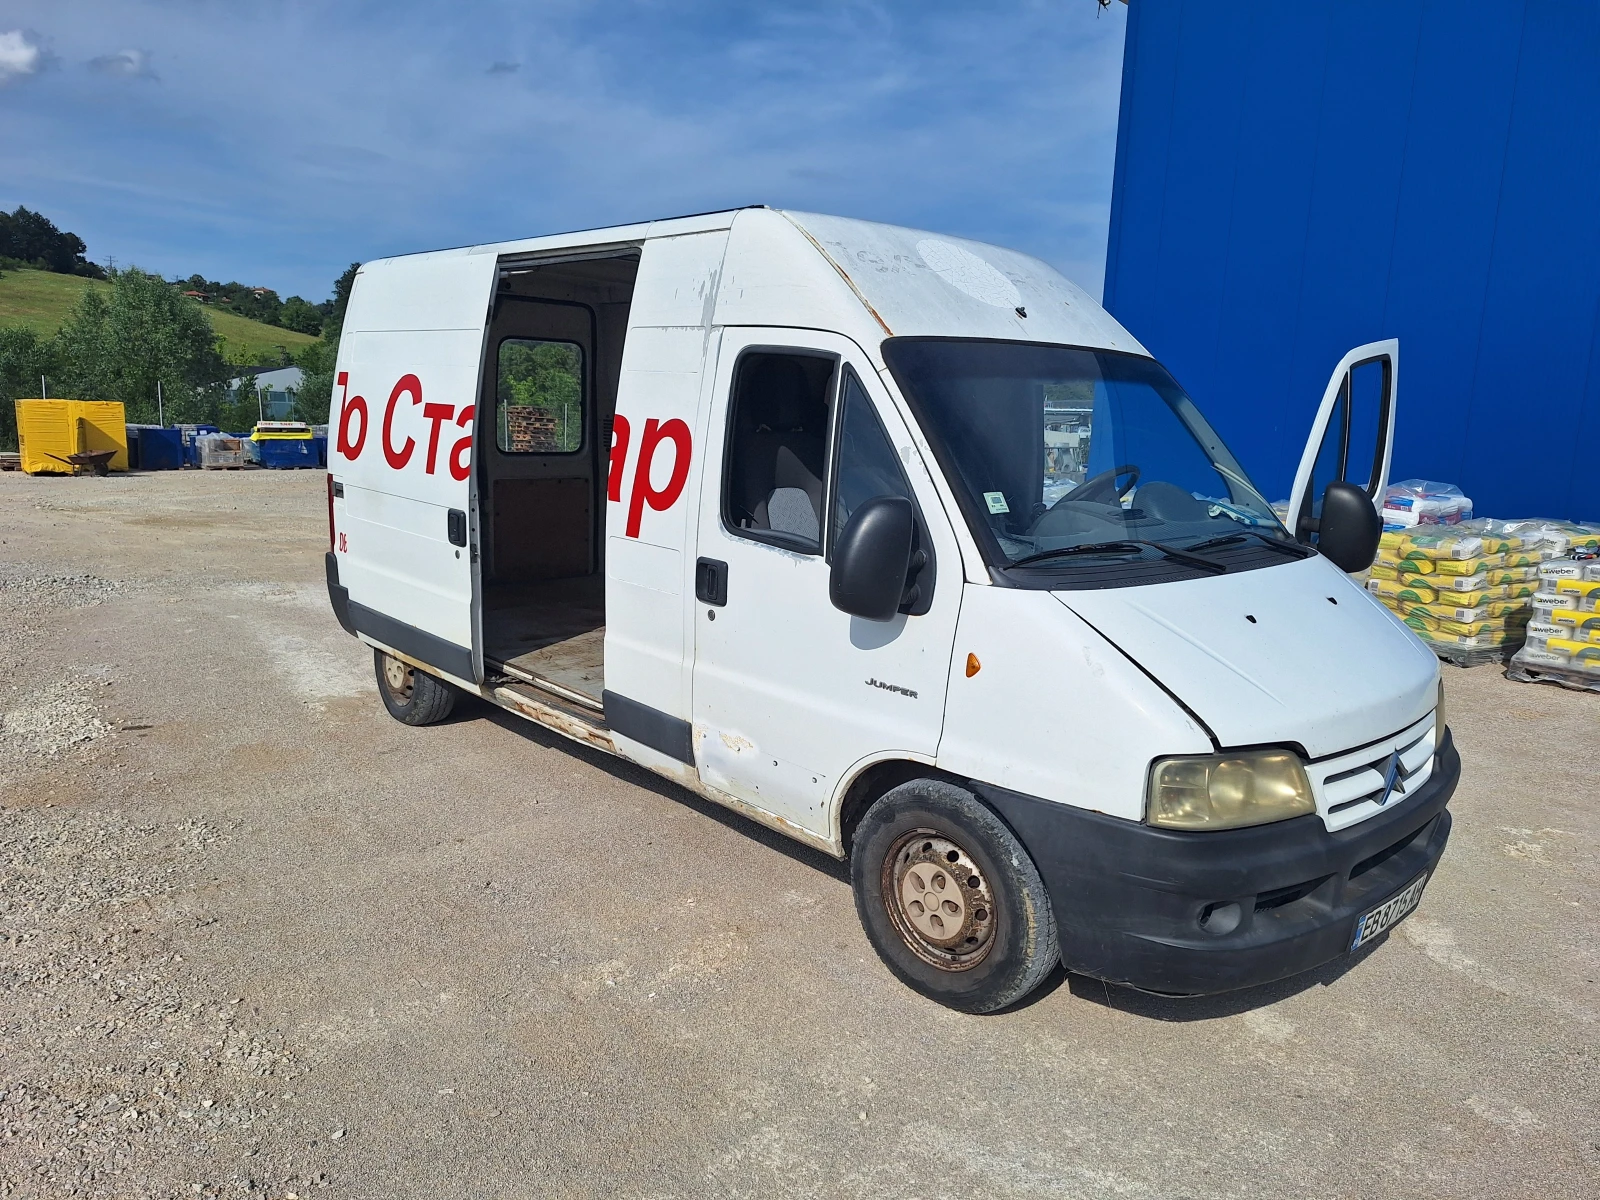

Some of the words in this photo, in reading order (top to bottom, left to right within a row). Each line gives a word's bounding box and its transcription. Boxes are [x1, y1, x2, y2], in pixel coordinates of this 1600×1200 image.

[1541, 596, 1569, 605] weber
[1536, 626, 1564, 634] weber
[1534, 653, 1561, 661] weber
[864, 677, 919, 699] JUMPER
